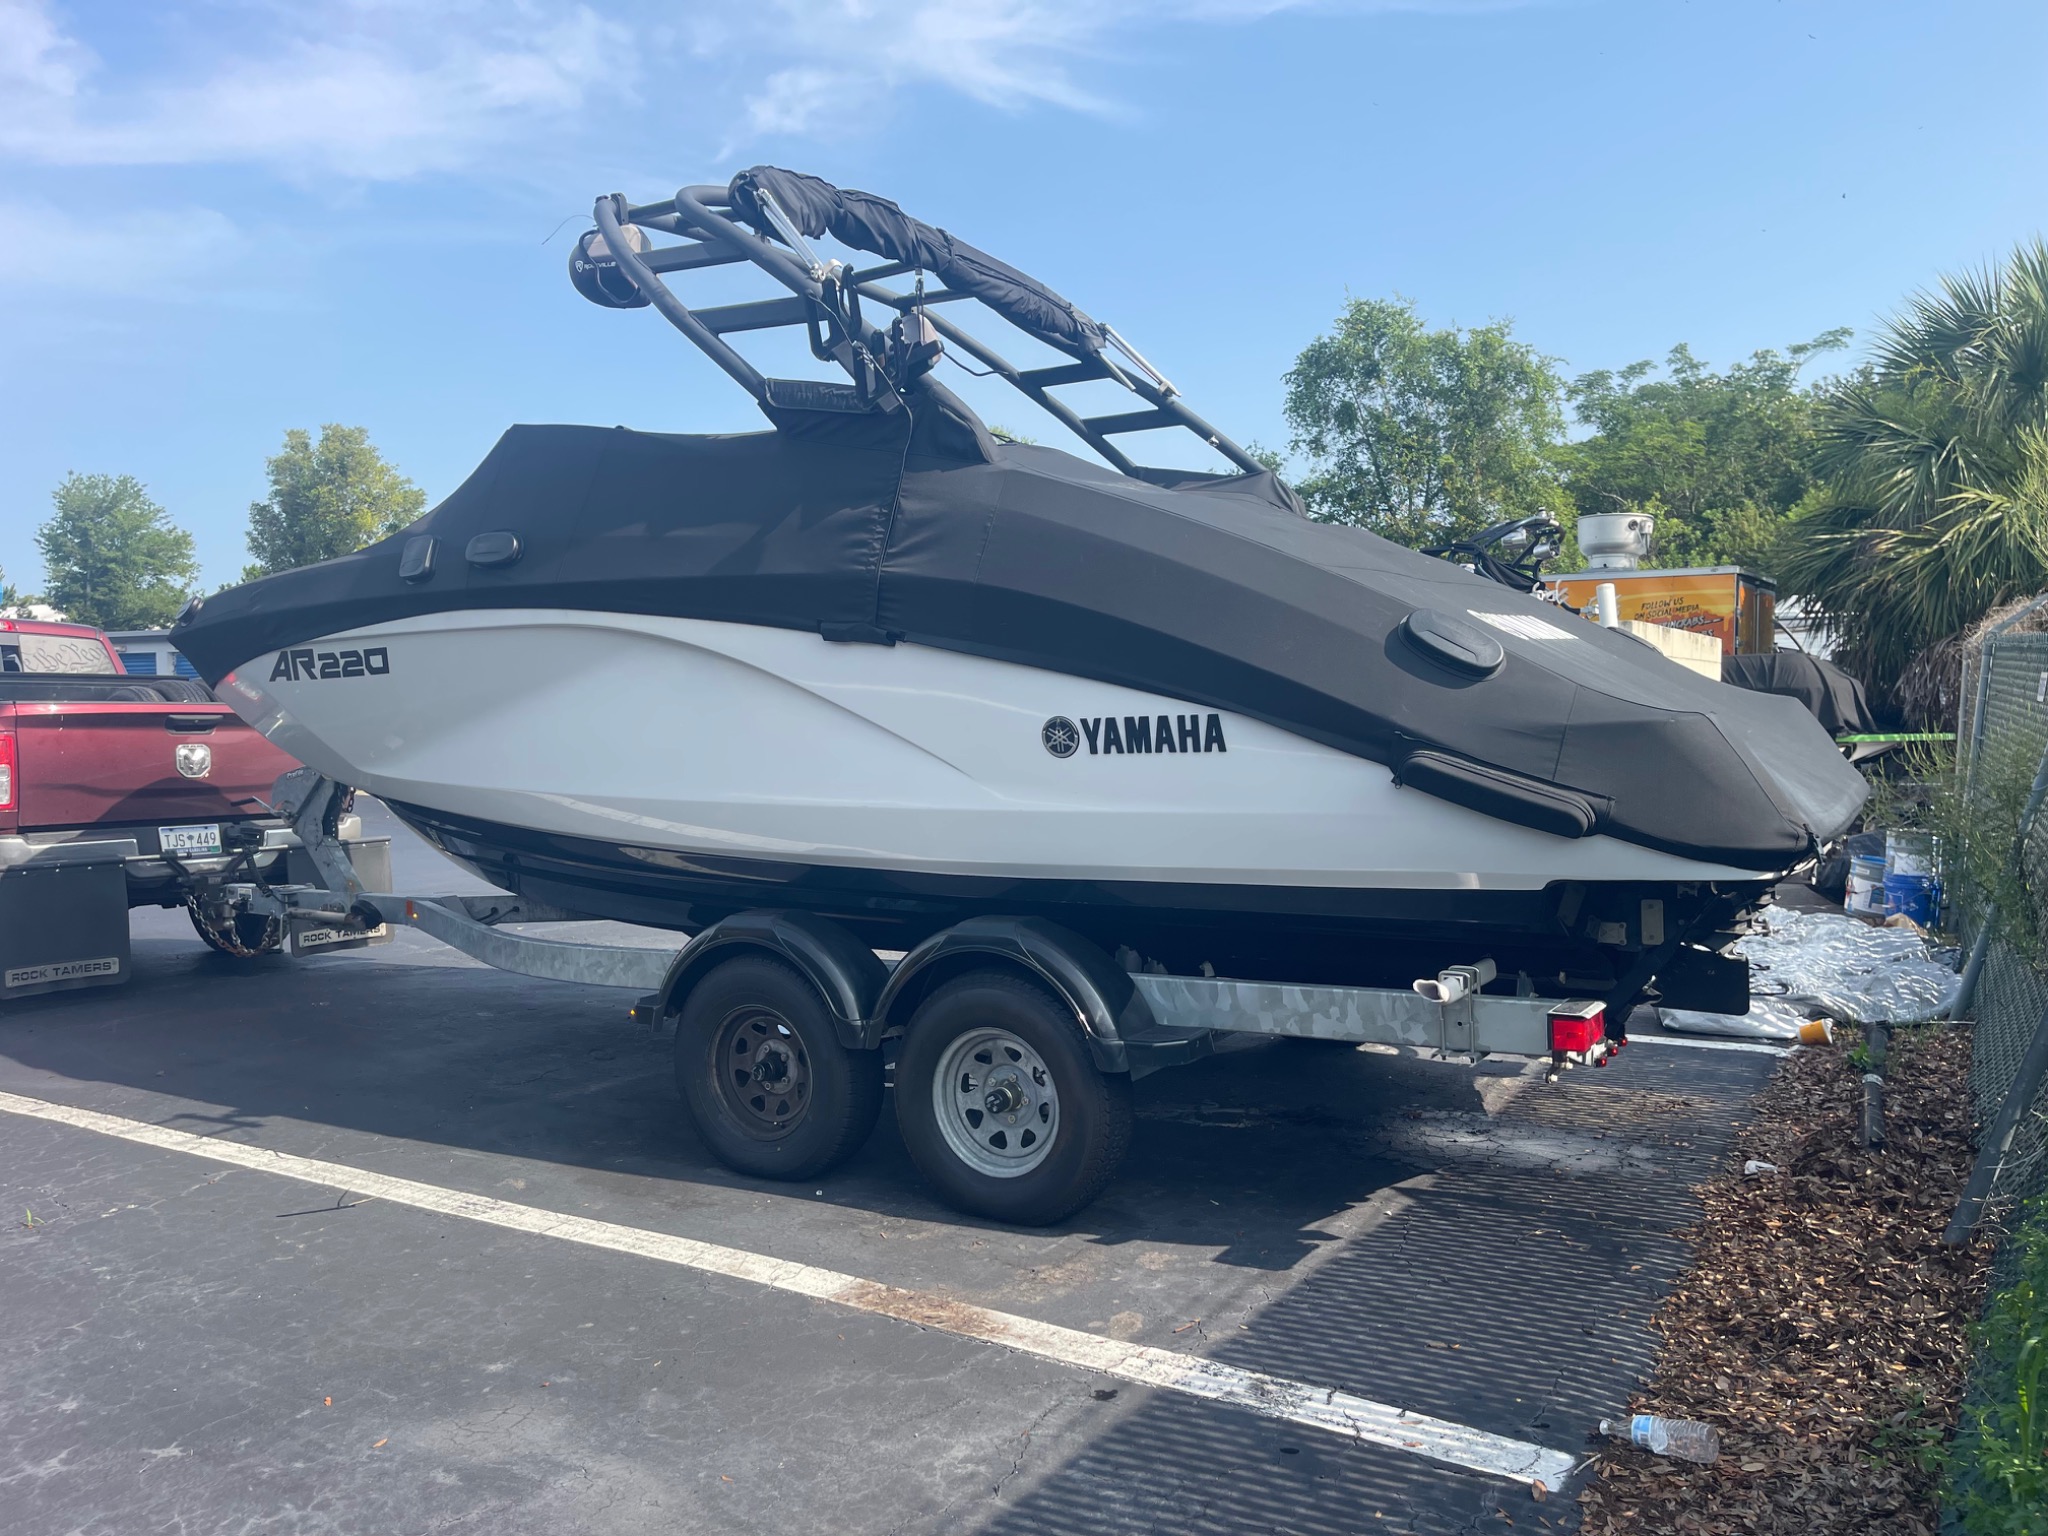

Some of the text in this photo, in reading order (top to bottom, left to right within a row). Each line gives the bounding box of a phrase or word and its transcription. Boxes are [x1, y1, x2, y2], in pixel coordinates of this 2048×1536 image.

[584, 261, 617, 270] ROVILLE
[1641, 597, 1684, 611] FOLLOW US
[1646, 608, 1672, 619] SOCIAL
[1675, 604, 1699, 613] MEDIA
[269, 647, 389, 682] AR220
[1080, 714, 1227, 755] YAMAHA
[164, 832, 216, 848] TJS 449
[303, 931, 332, 944] ROCK
[12, 962, 111, 982] ROCK TAMERS
